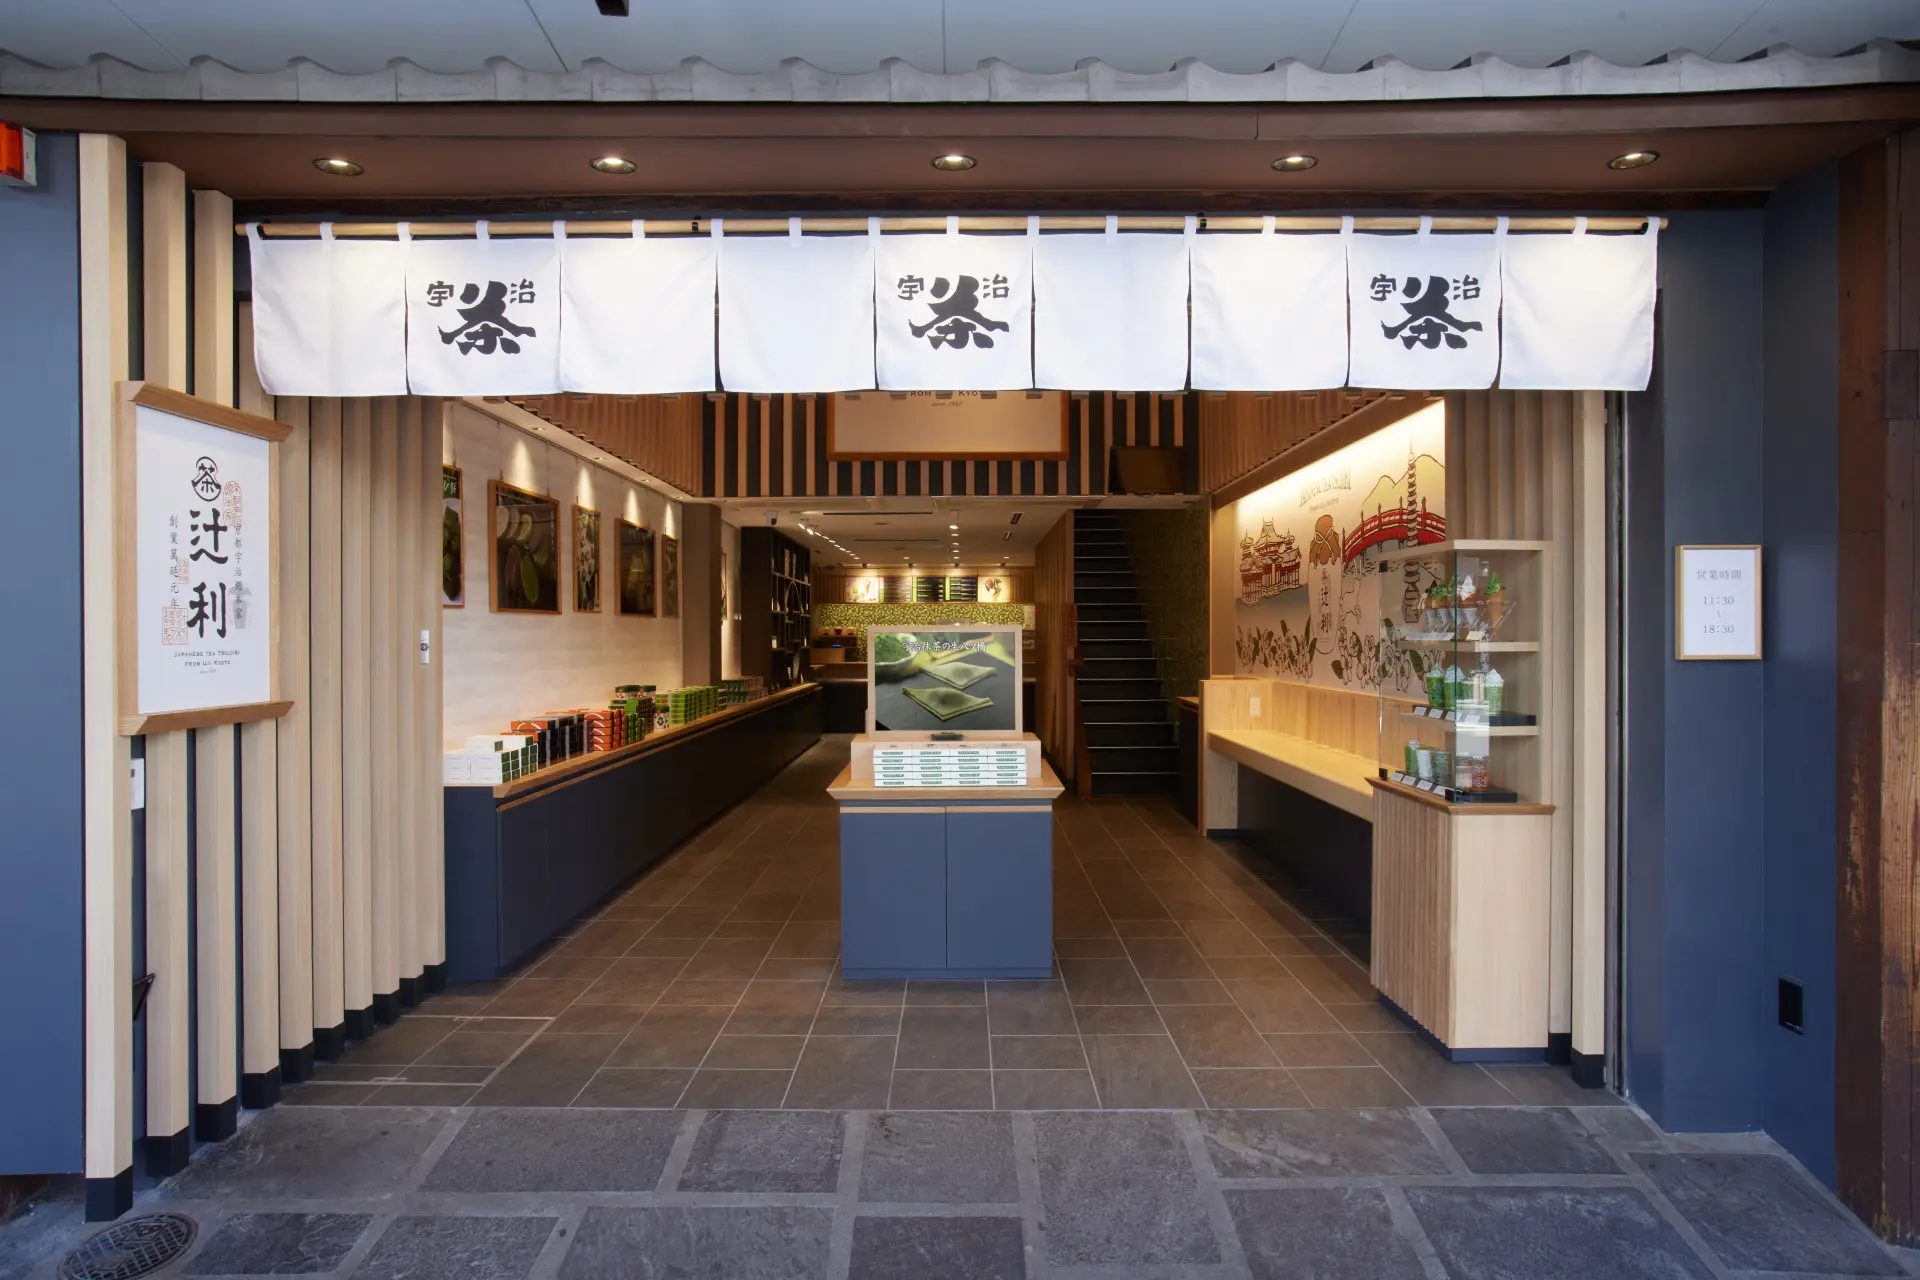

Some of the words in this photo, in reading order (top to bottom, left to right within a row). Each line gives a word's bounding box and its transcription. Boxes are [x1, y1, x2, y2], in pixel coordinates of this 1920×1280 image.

[186, 507, 229, 639] 辻利
[1696, 569, 1742, 581] 営業時間
[1703, 596, 1735, 605] 11:30
[1703, 624, 1735, 634] 18:30
